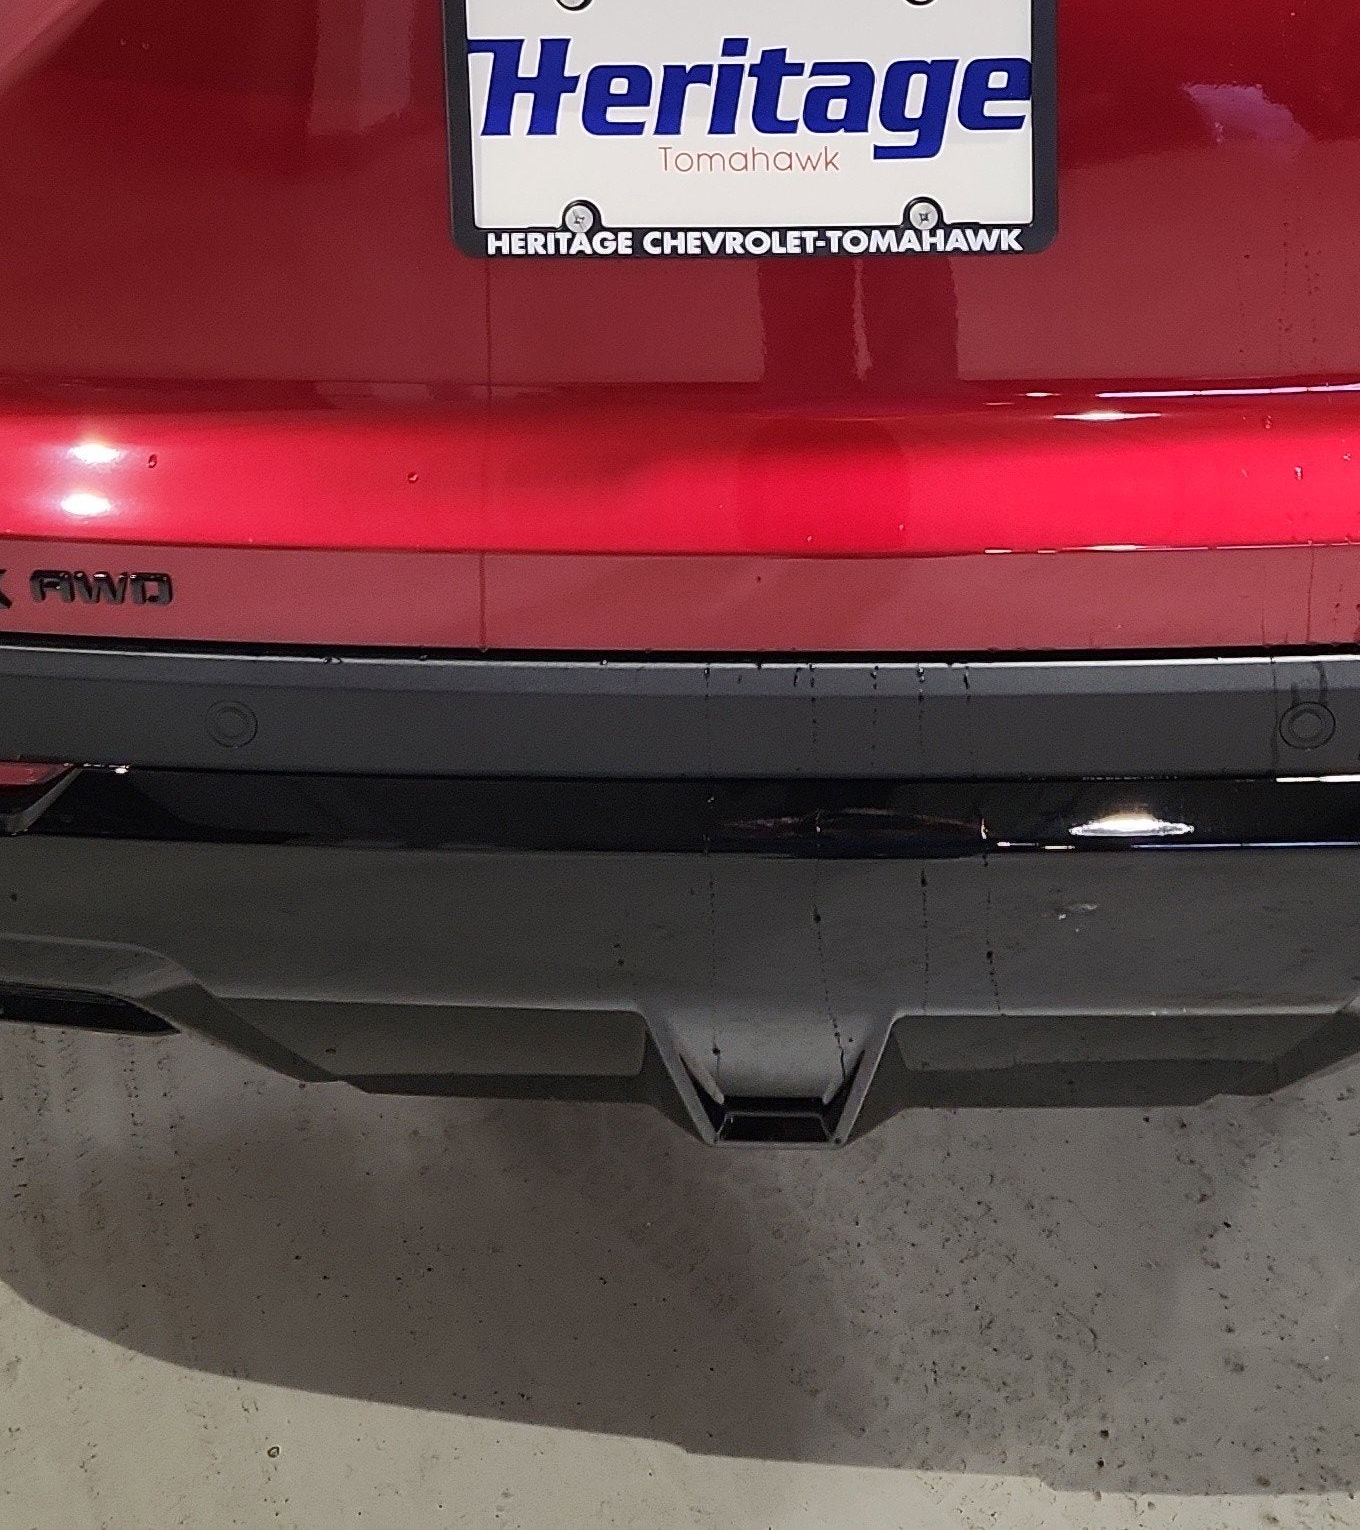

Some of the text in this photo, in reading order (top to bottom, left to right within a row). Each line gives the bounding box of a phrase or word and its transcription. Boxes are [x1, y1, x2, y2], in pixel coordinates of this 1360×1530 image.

[466, 37, 1033, 160] Heritage
[658, 145, 840, 173] Tomahawk
[487, 228, 1024, 257] HERITAGE CHEVROLET-TOMAHAWK
[30, 568, 174, 606] AWD
